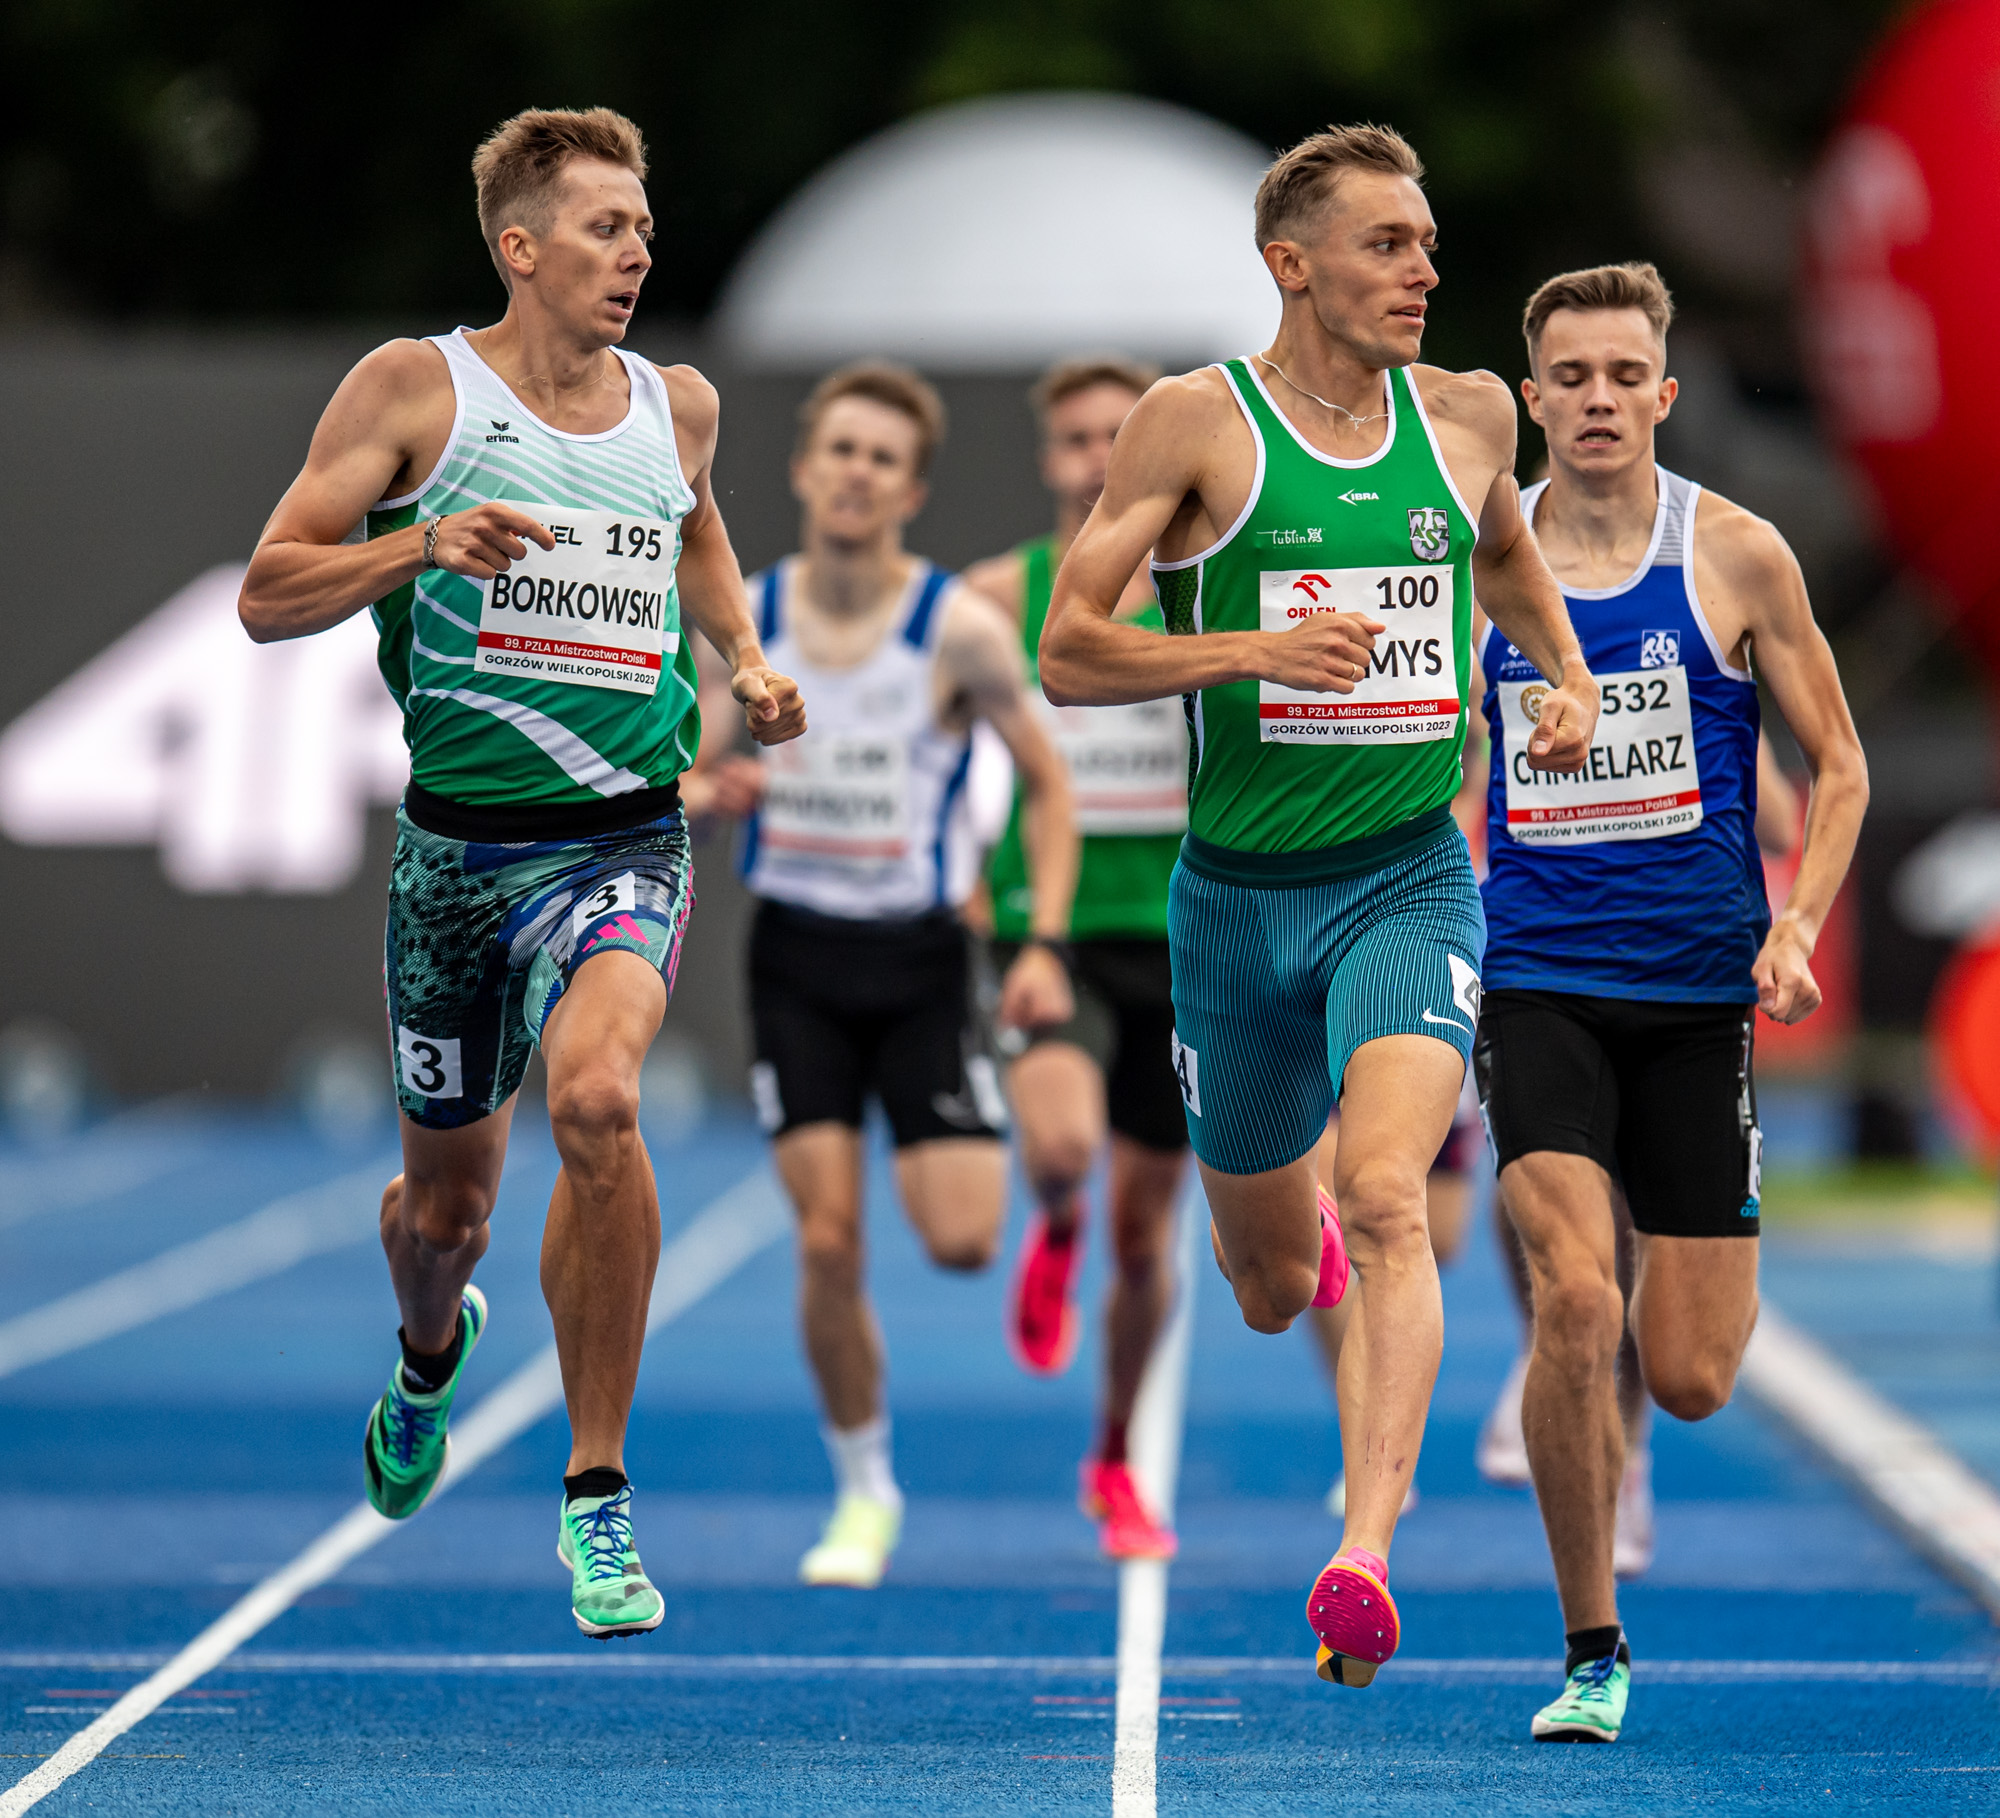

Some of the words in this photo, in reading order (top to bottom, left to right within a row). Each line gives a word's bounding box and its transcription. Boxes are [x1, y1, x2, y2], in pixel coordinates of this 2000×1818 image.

[486, 433, 520, 444] erima
[606, 523, 662, 561] 195
[491, 572, 662, 630] BORKOWSKI
[1376, 575, 1439, 610] 100
[503, 637, 522, 651] 99.
[524, 640, 551, 655] PZLA
[553, 643, 619, 662] Mistrzostwa
[620, 652, 647, 666] Polski
[1364, 638, 1442, 679] MYS
[484, 653, 544, 670] GORZÓW
[546, 661, 633, 682] WIELKOPOLSKI
[634, 672, 656, 686] 2023
[1287, 705, 1305, 717] 99.
[1308, 705, 1335, 718] PZLA
[1338, 704, 1406, 717] Mistrzostwa
[1408, 702, 1439, 714] Polski
[1602, 679, 1671, 716] 532
[1269, 721, 1338, 735] GORZÓW
[1339, 722, 1424, 736] WIELKOPOLSKI
[1426, 720, 1451, 732] 2023
[1517, 824, 1572, 839] GORZÓW
[1572, 817, 1664, 836] WIELKOPOLSKI
[1666, 810, 1695, 825] 2023
[1548, 808, 1575, 821] PZLA
[1576, 800, 1643, 819] Mistrzostwa
[1645, 795, 1678, 809] Polski
[584, 884, 619, 920] 3
[410, 1040, 447, 1093] 3
[1177, 1047, 1193, 1104] 4
